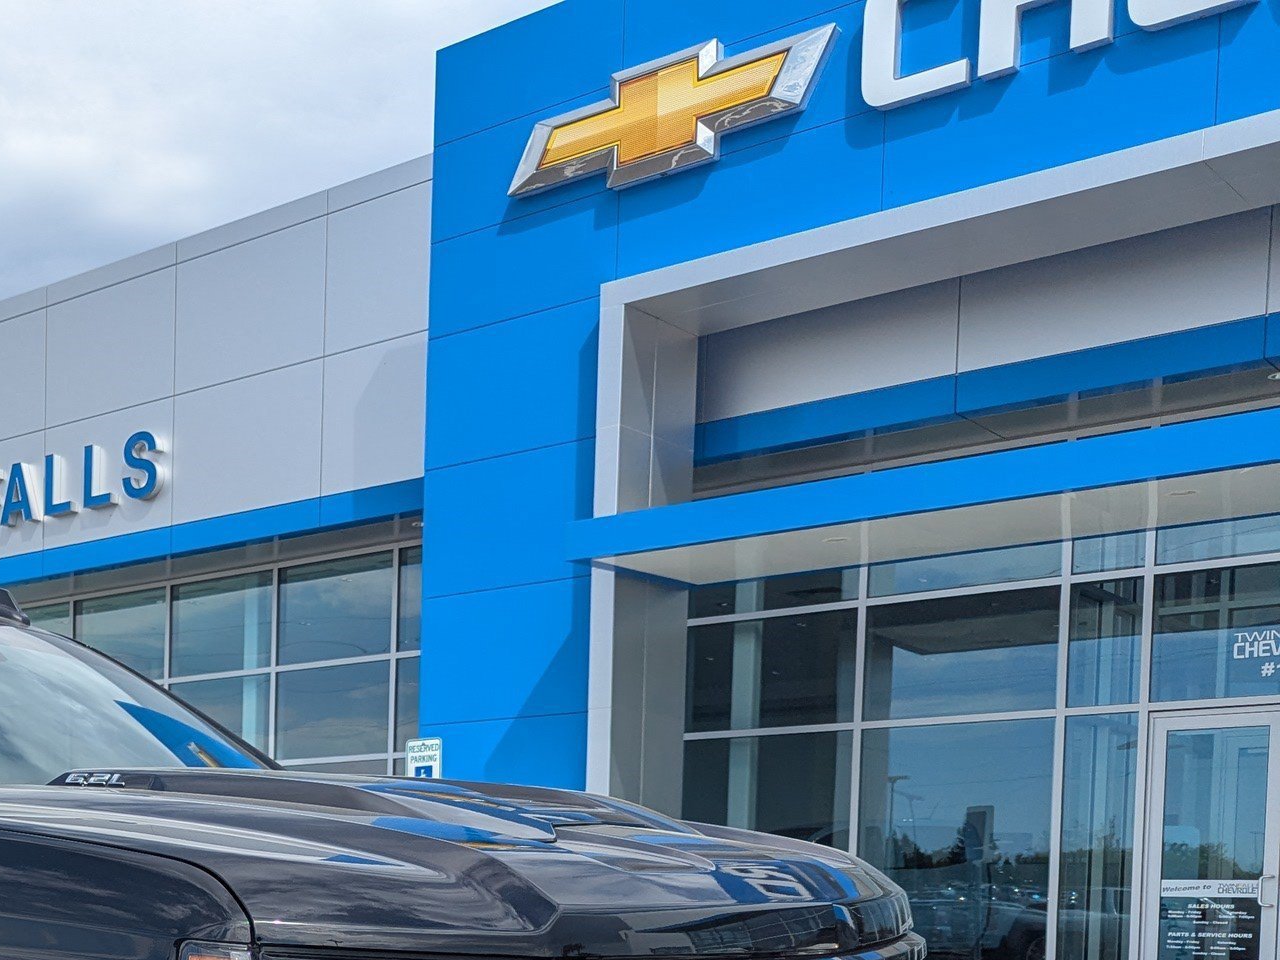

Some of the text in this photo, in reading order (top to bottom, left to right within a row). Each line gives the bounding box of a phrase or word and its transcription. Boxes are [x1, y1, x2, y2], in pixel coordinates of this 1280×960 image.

[408, 743, 439, 754] RESERVED
[410, 754, 437, 764] PARKING
[1162, 885, 1200, 893] Welcome
